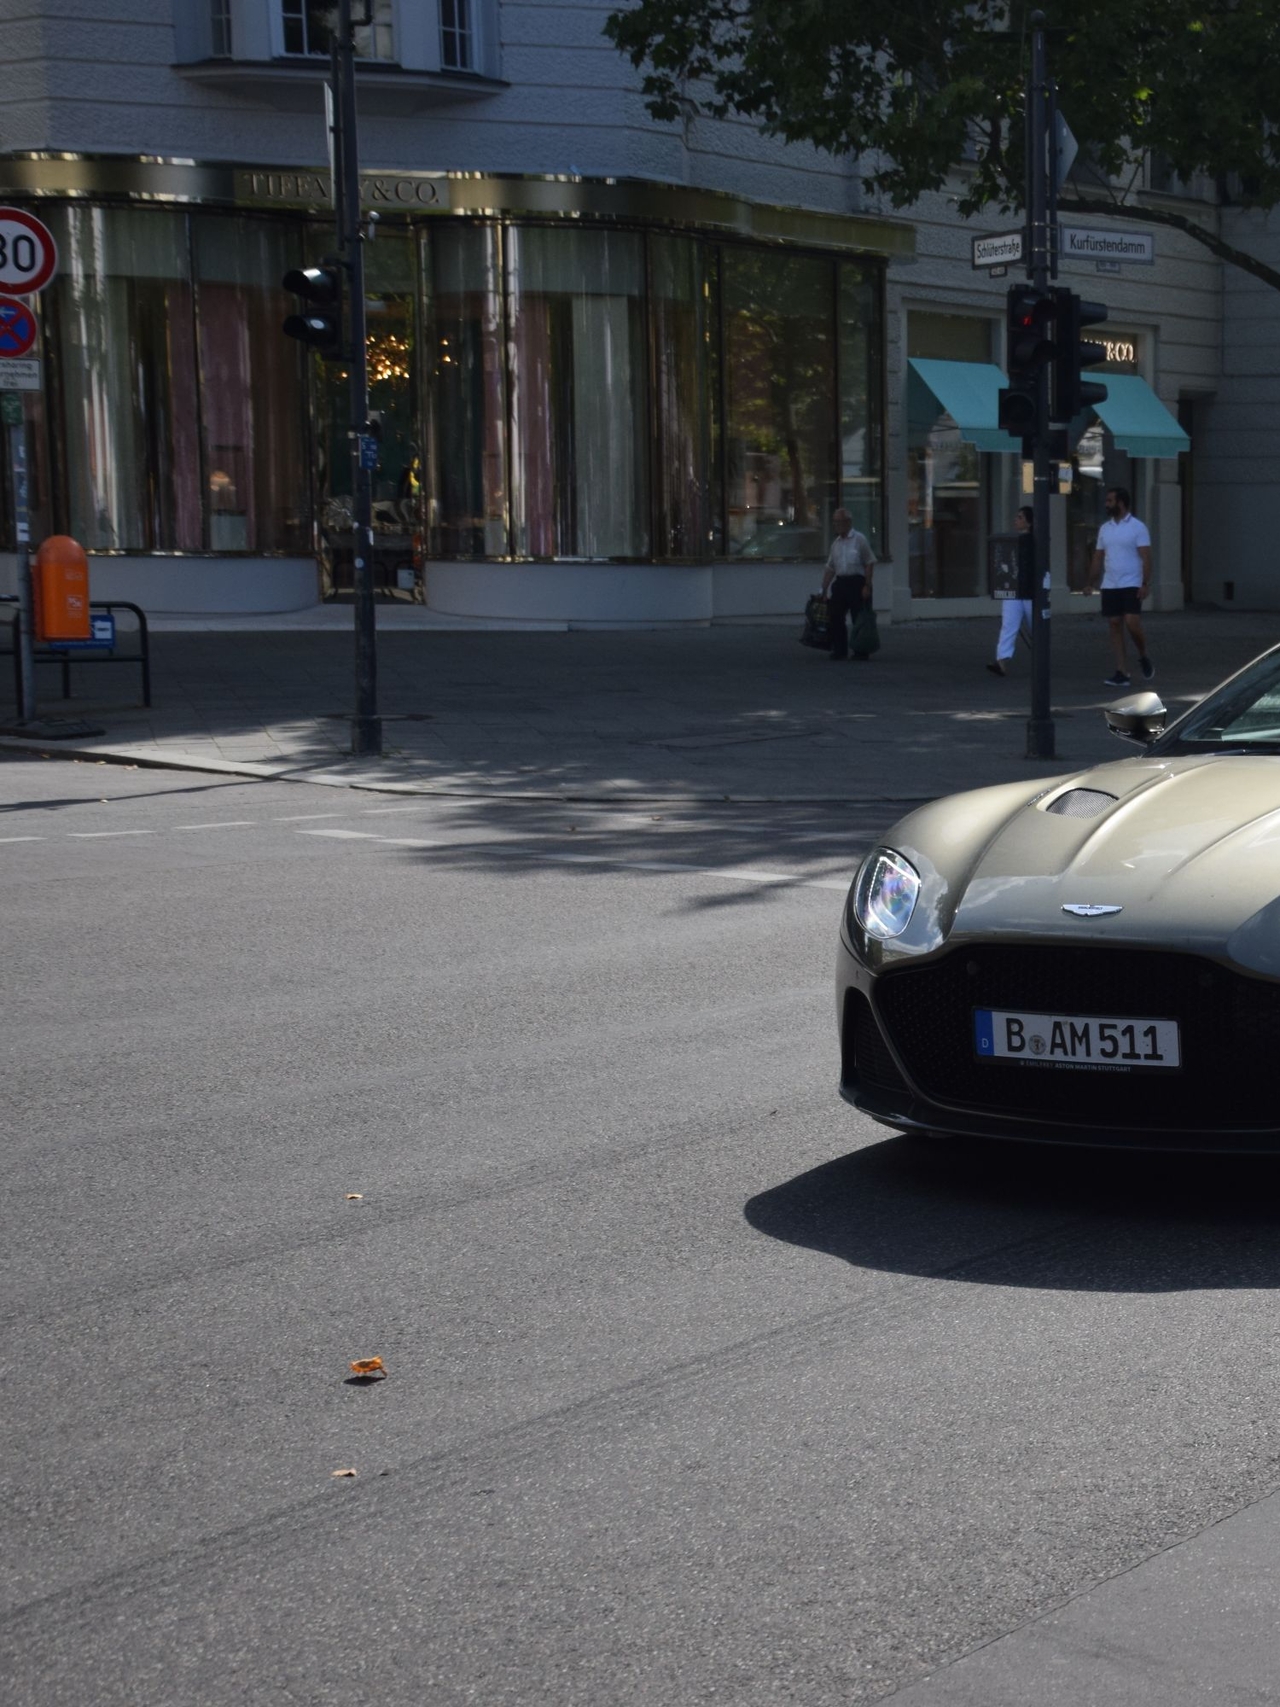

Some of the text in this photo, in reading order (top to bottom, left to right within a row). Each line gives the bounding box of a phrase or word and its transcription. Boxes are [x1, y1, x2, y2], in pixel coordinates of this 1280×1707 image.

[977, 238, 1020, 259] Schlüterstraße
[1070, 233, 1146, 254] Kurfürstendamm
[981, 1037, 990, 1049] D
[1005, 1017, 1164, 1061] B AM 511
